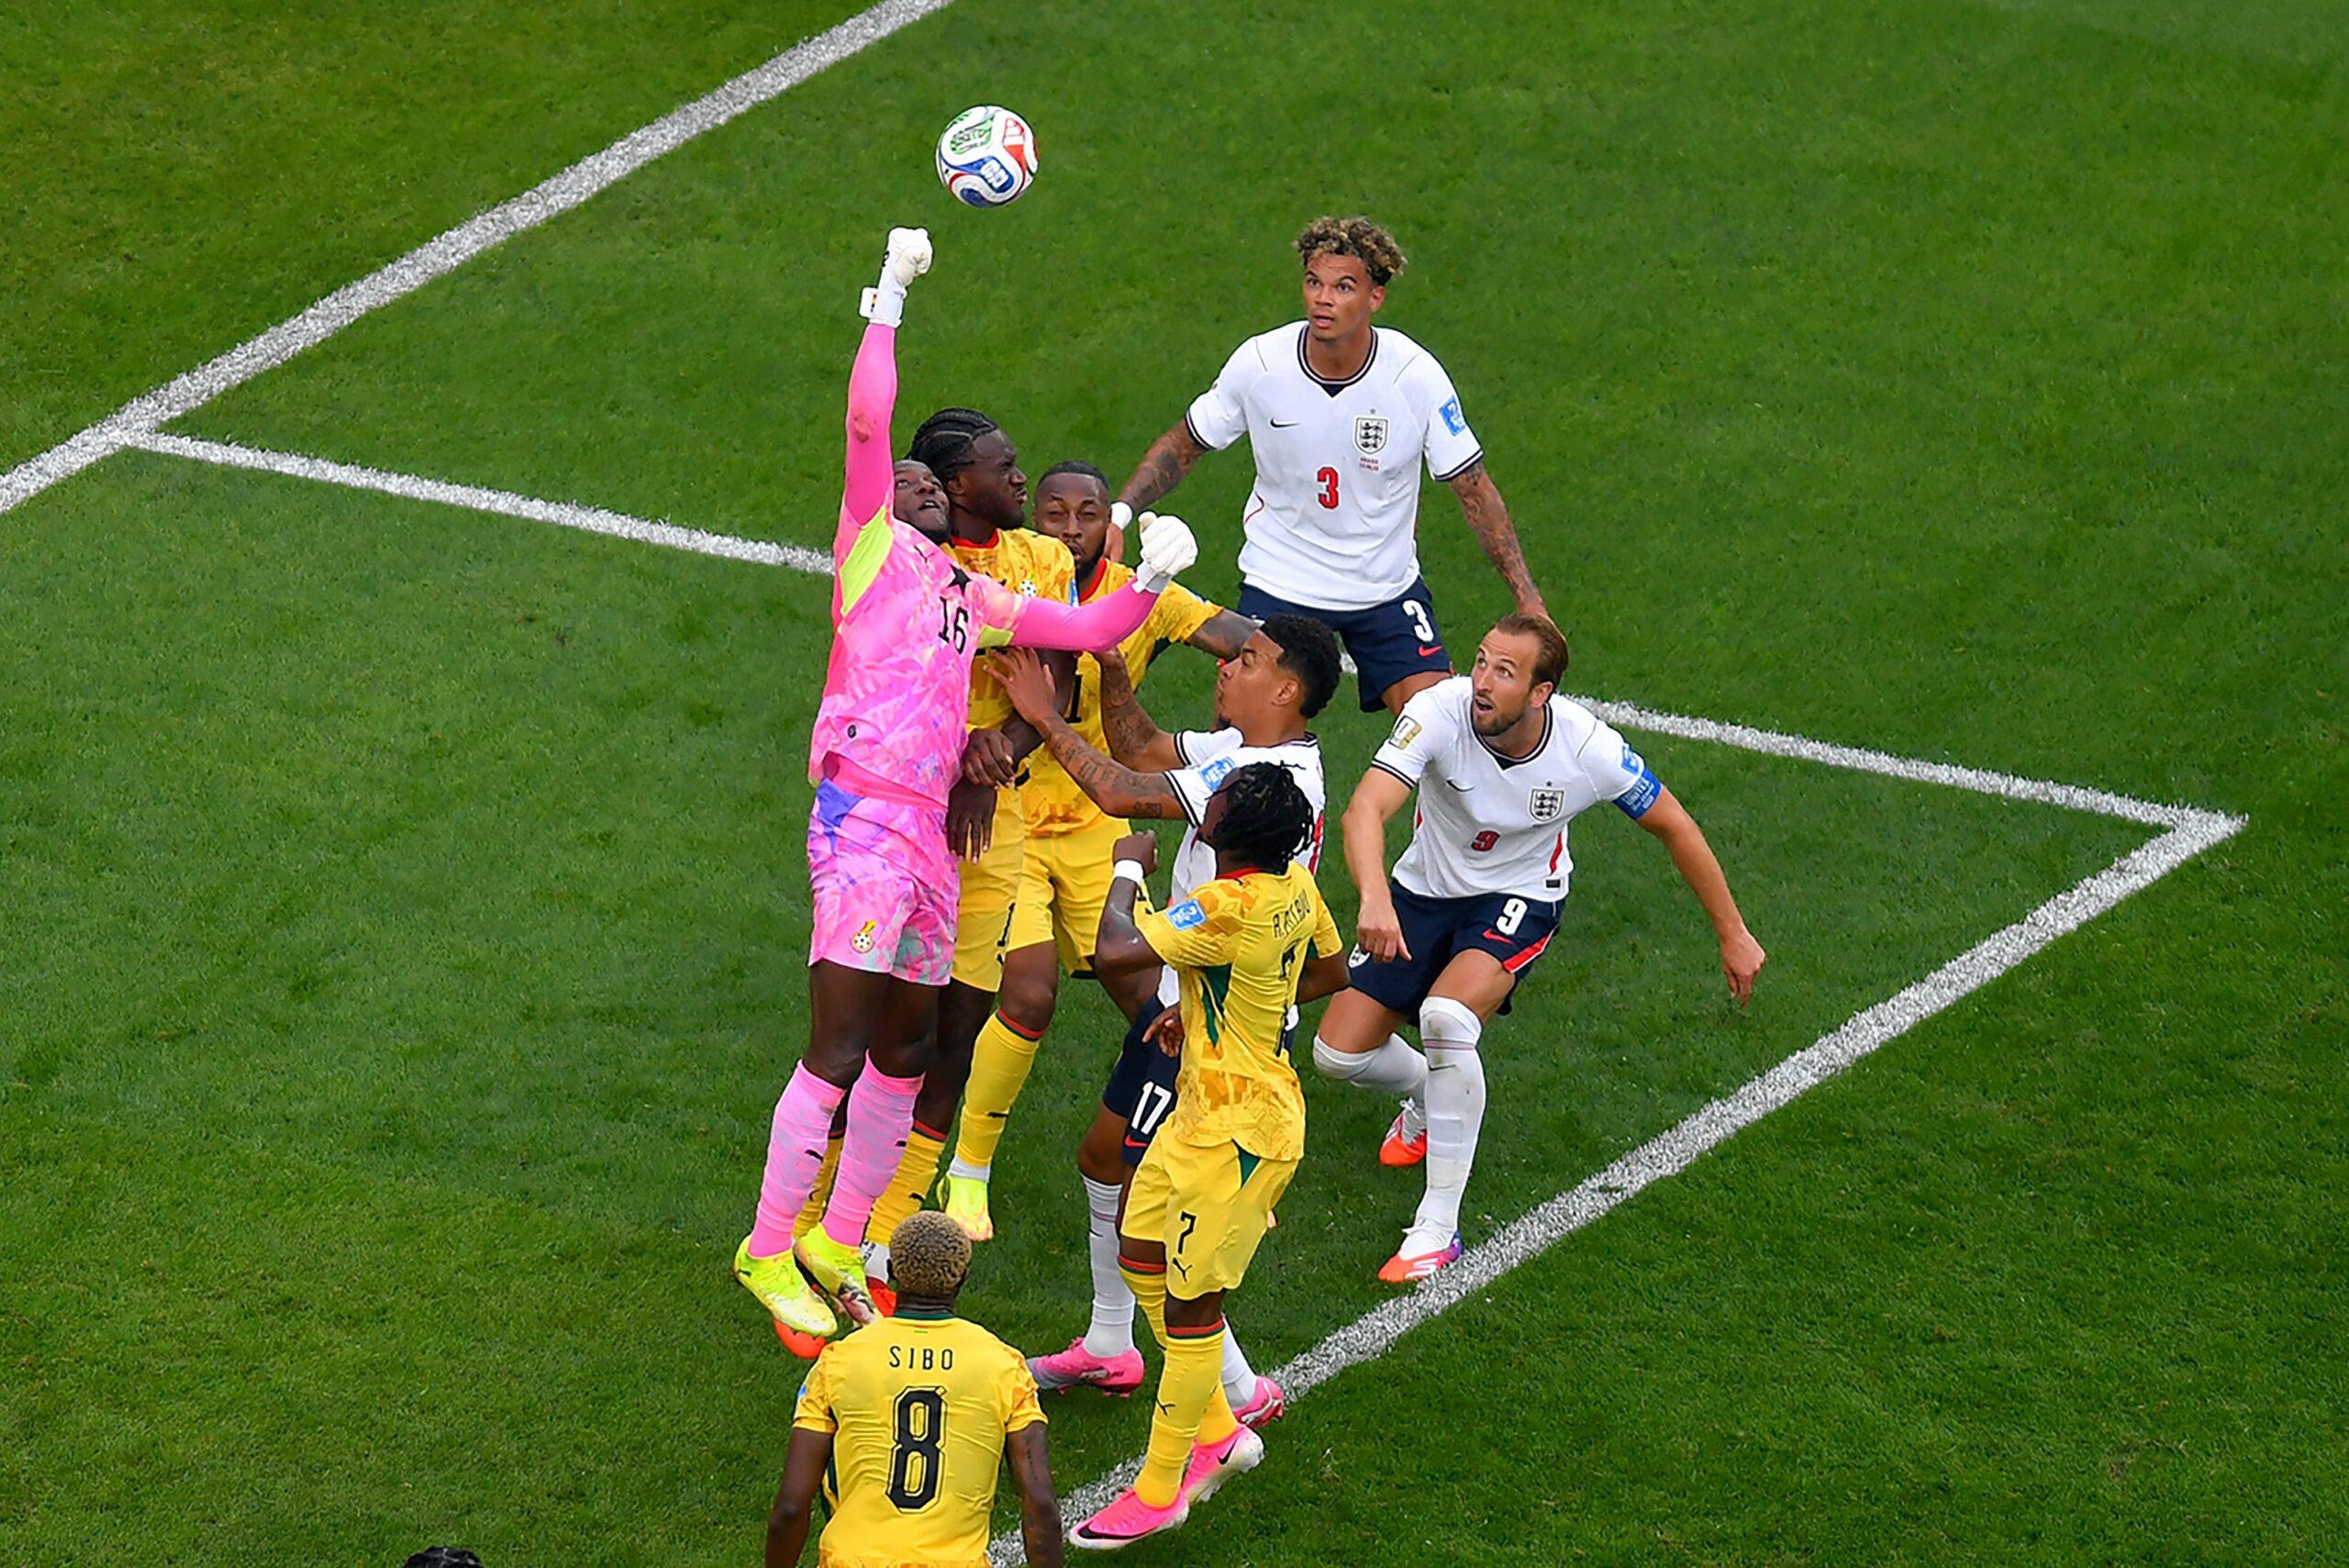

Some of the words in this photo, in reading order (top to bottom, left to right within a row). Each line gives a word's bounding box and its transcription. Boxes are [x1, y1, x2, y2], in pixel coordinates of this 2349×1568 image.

[1317, 466, 1339, 509] 3
[939, 596, 968, 654] 16
[1402, 600, 1433, 642] 3
[1471, 830, 1500, 851] 9
[1496, 898, 1528, 935] 9
[1131, 1081, 1172, 1135] 17
[1177, 1211, 1197, 1255] 7
[889, 1346, 953, 1371] SIBO
[885, 1385, 949, 1515] 8
